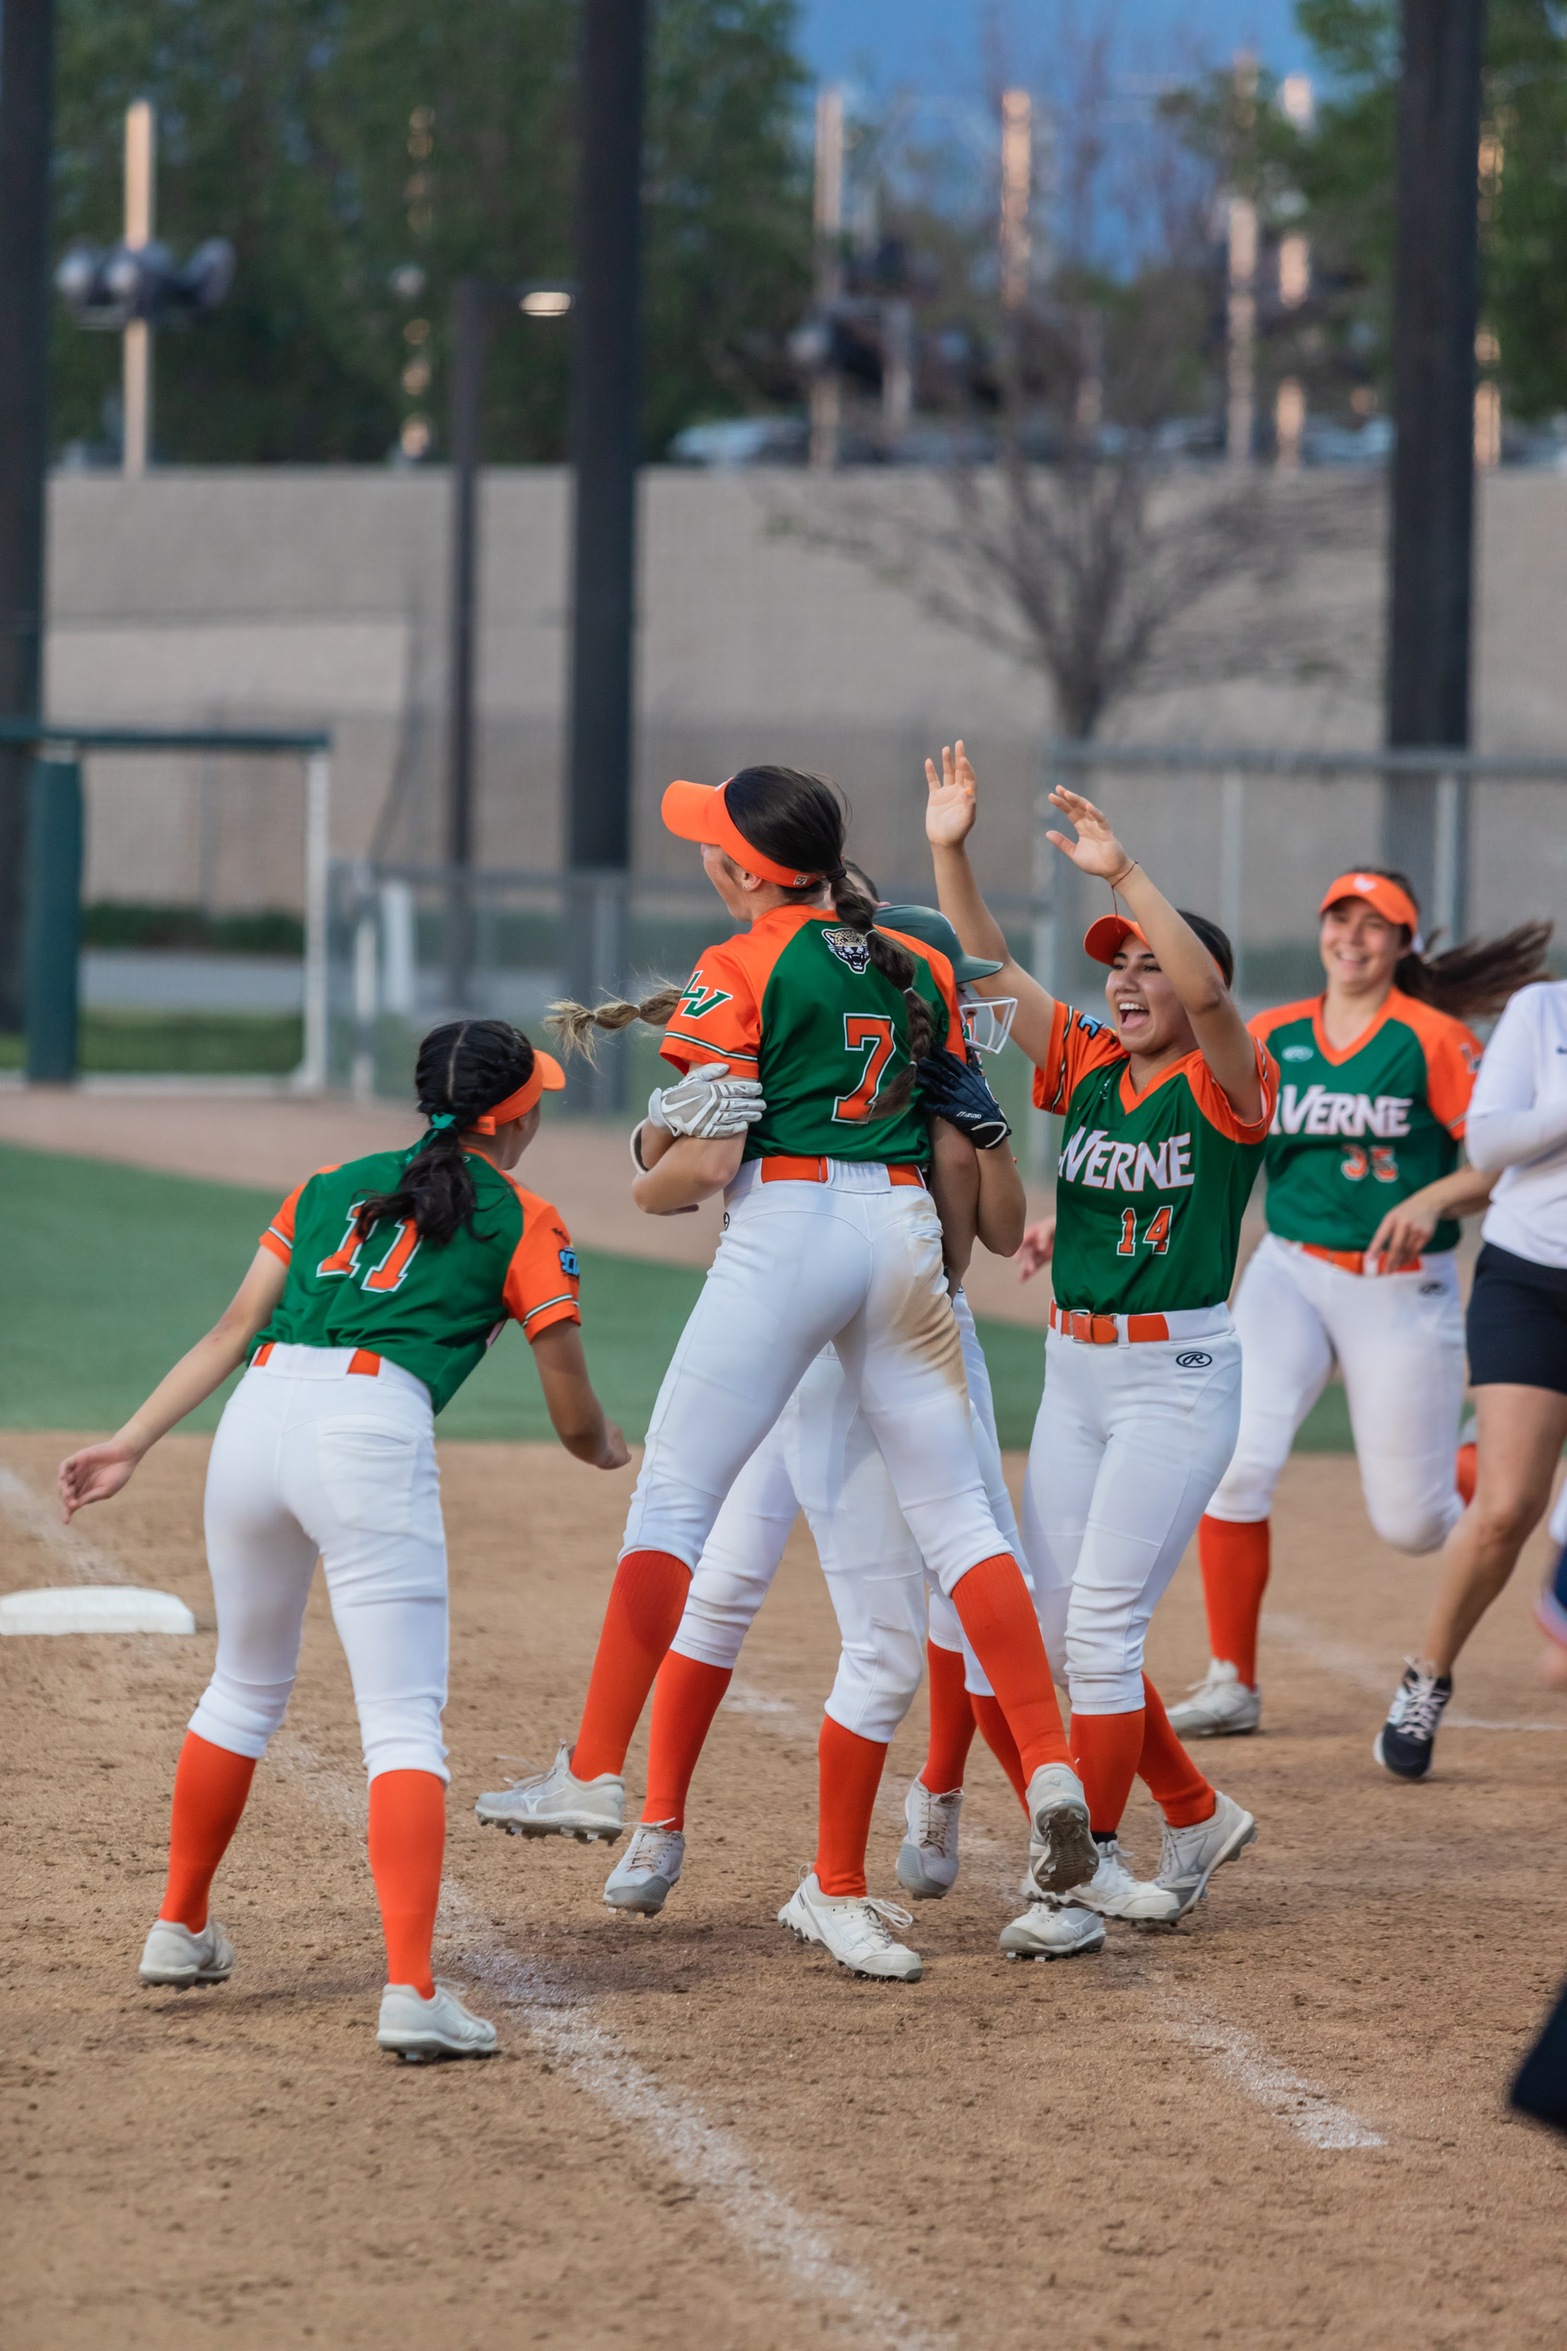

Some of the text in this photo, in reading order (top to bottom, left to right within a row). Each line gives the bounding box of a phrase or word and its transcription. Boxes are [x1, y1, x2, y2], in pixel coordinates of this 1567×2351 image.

[831, 1013, 897, 1125] 7
[1340, 1144, 1398, 1183] 35
[1116, 1205, 1173, 1256] 14
